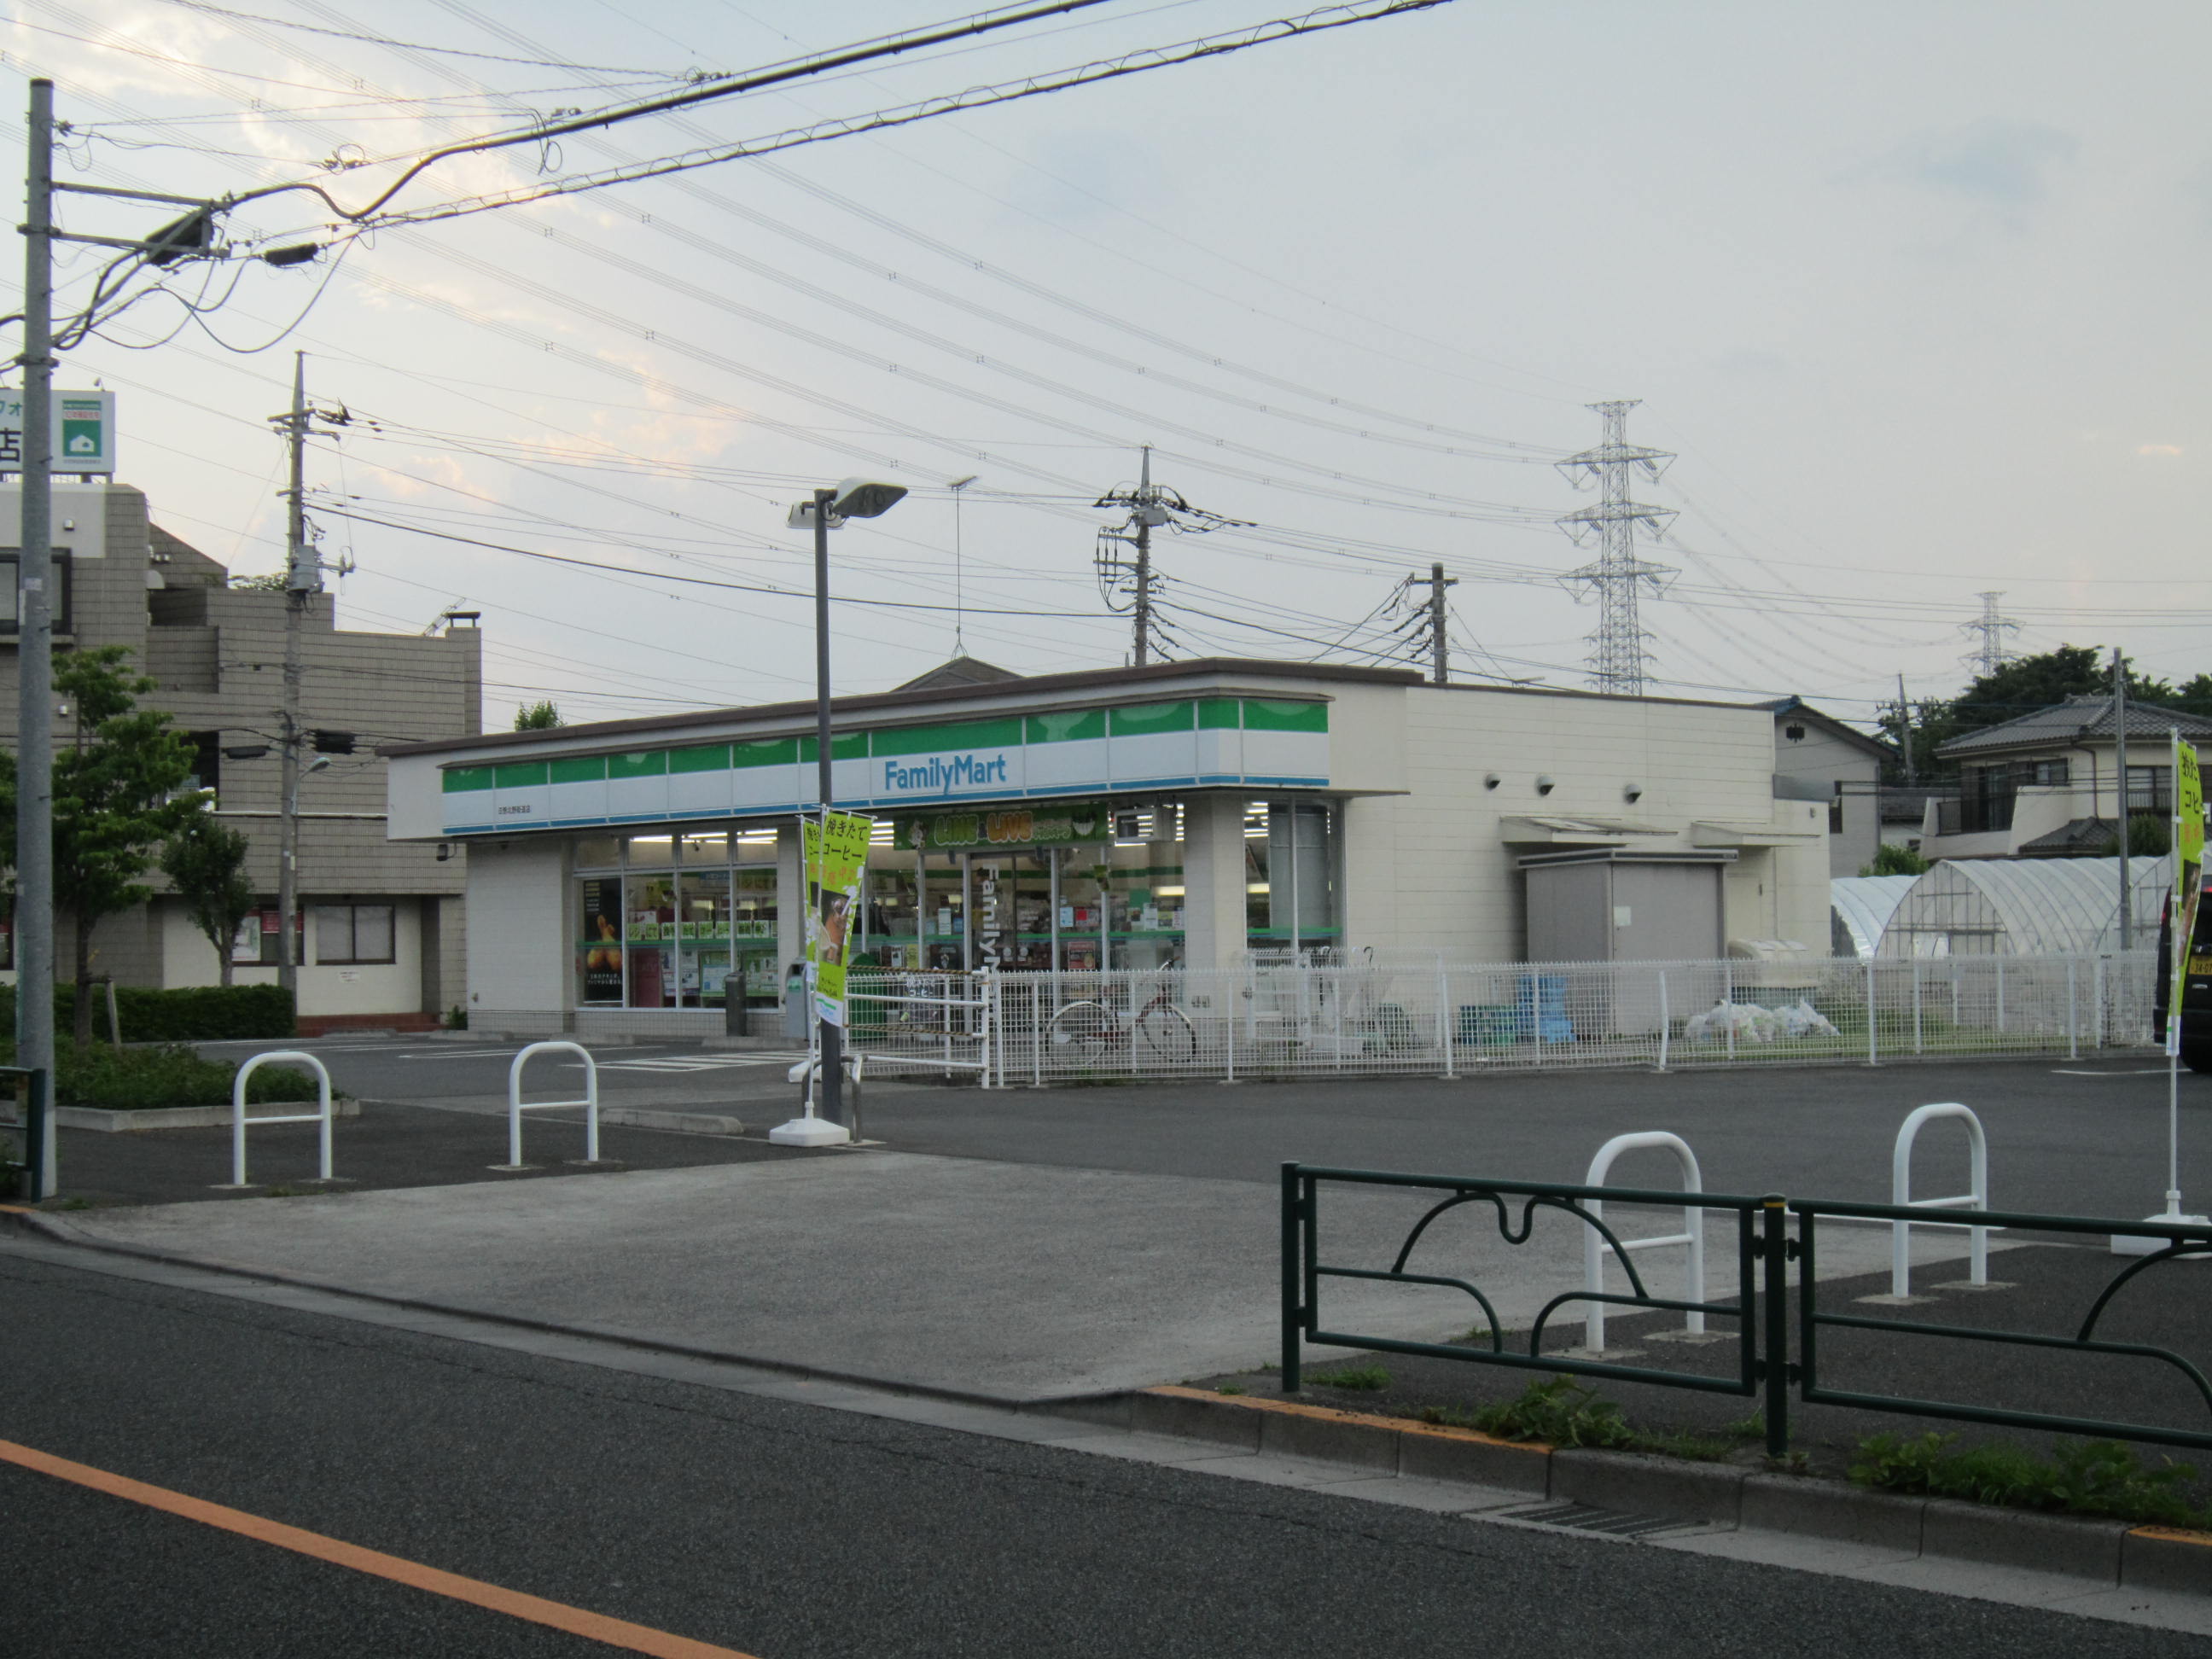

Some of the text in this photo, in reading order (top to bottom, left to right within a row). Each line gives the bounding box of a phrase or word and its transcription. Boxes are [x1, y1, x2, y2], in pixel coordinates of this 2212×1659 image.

[885, 754, 1006, 795] FamilyMart
[826, 818, 867, 841] 挽きたて
[824, 843, 862, 860] コーヒー
